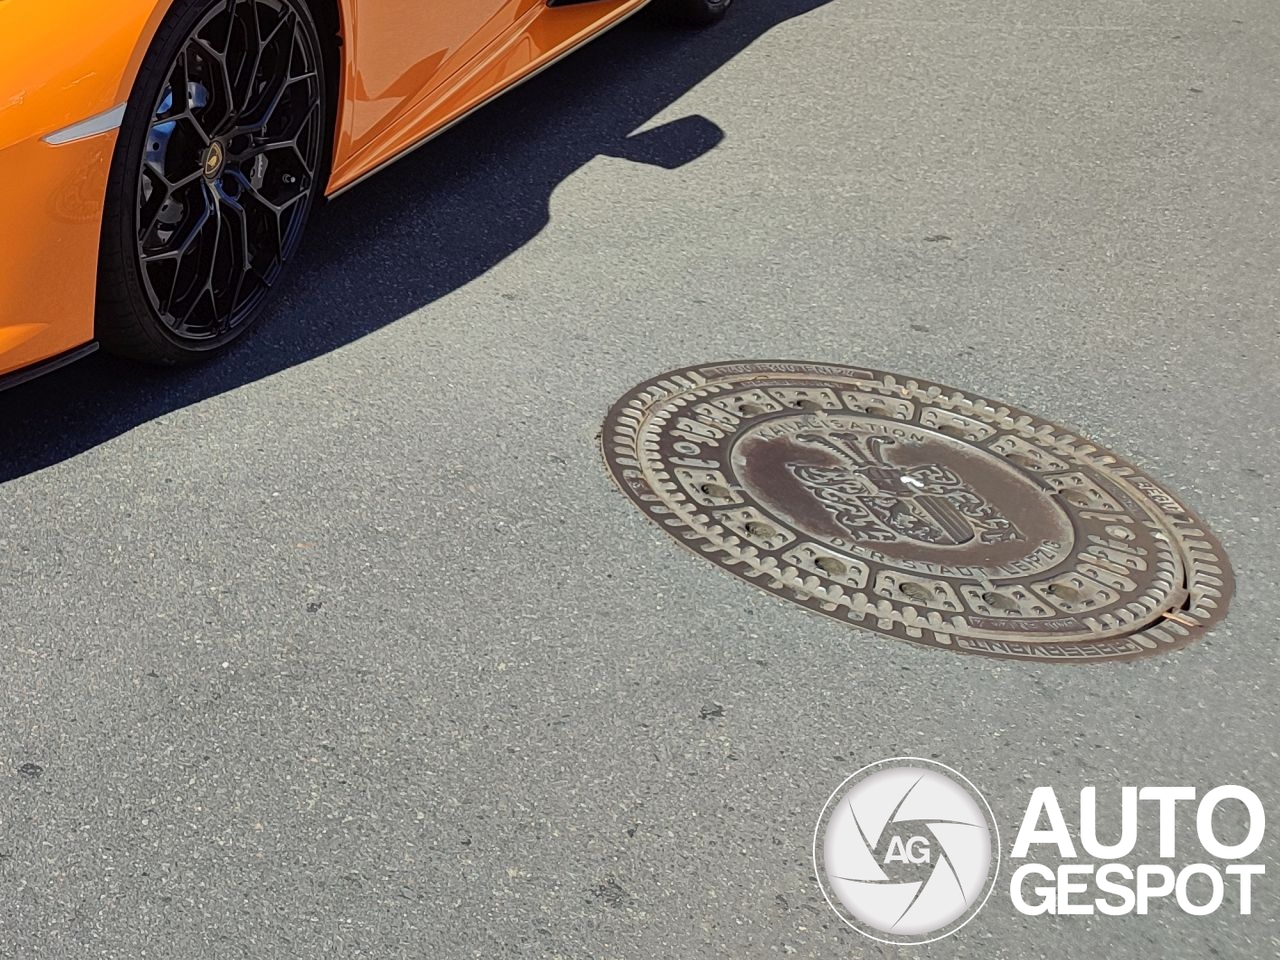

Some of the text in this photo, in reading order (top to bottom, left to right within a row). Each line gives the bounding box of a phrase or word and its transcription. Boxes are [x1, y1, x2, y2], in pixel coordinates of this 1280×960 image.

[831, 537, 1062, 578] DER STADT LEIPZIG
